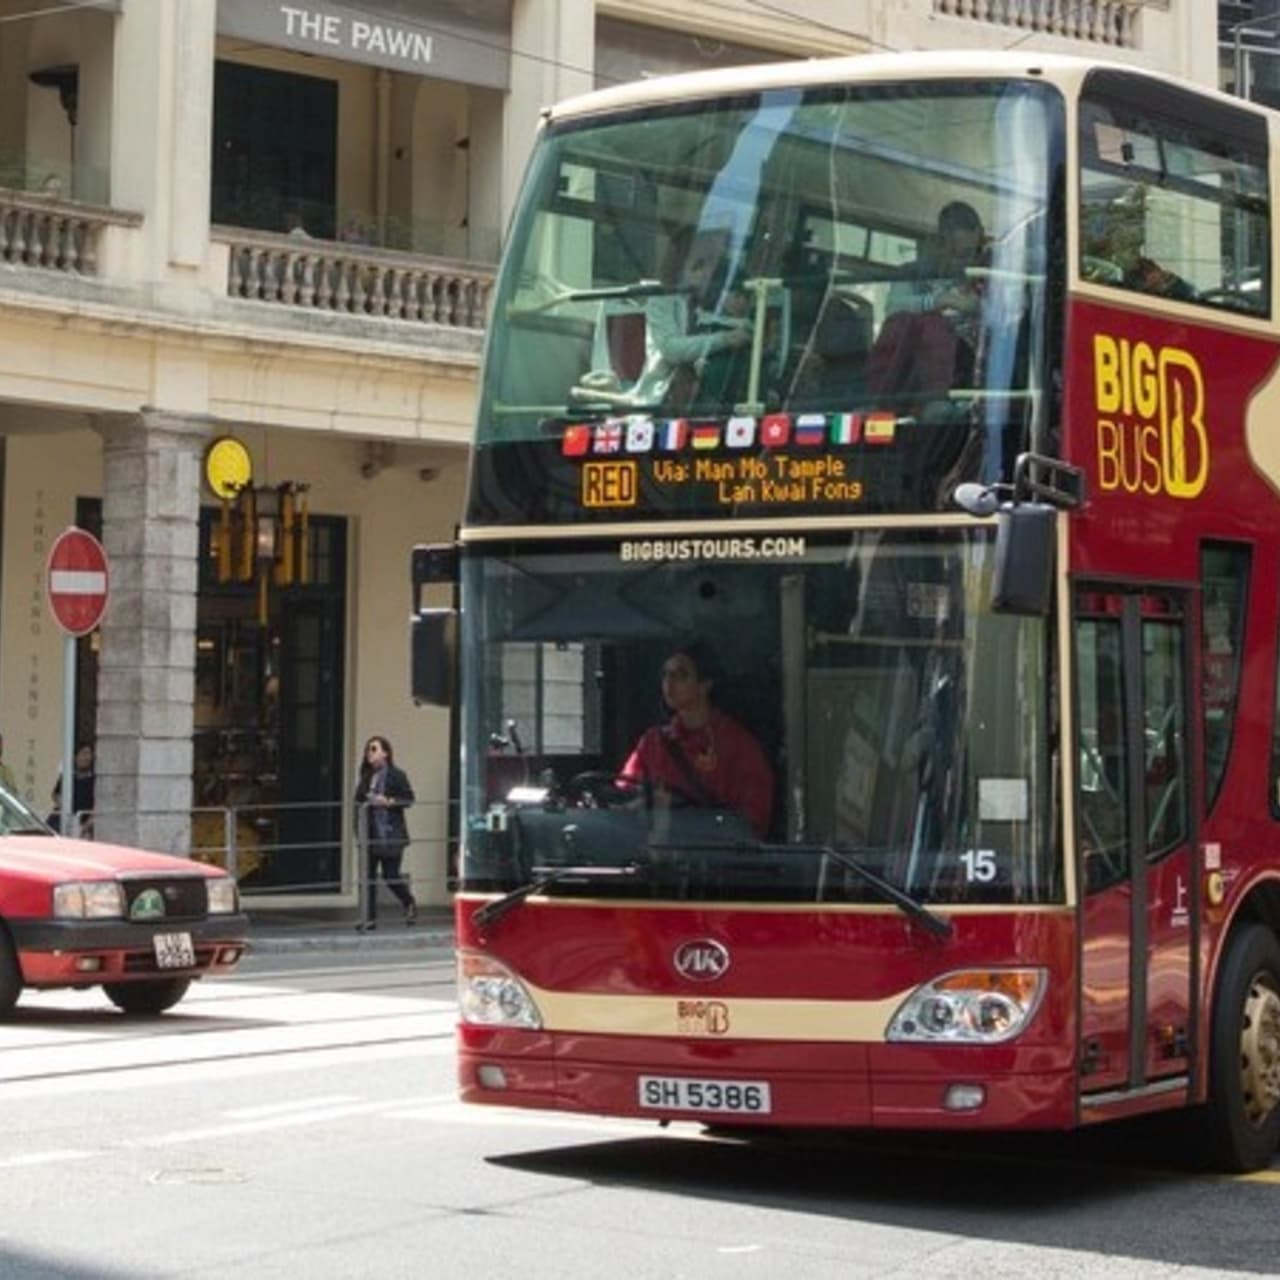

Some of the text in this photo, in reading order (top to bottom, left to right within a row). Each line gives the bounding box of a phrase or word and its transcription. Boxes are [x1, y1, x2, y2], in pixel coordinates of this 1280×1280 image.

[280, 5, 434, 63] THE PAWN
[1094, 334, 1158, 419] BIG
[653, 460, 689, 481] Via:
[696, 459, 734, 480] Man
[740, 458, 768, 479] Mo
[1097, 420, 1162, 495] BUS
[585, 464, 634, 503] RED
[719, 477, 863, 502] Lan Kwai Fong
[621, 537, 806, 561] BIGBUSTOURS.COM
[959, 850, 996, 882] 15
[677, 1000, 706, 1018] BIG
[644, 1080, 762, 1111] SH 5386
